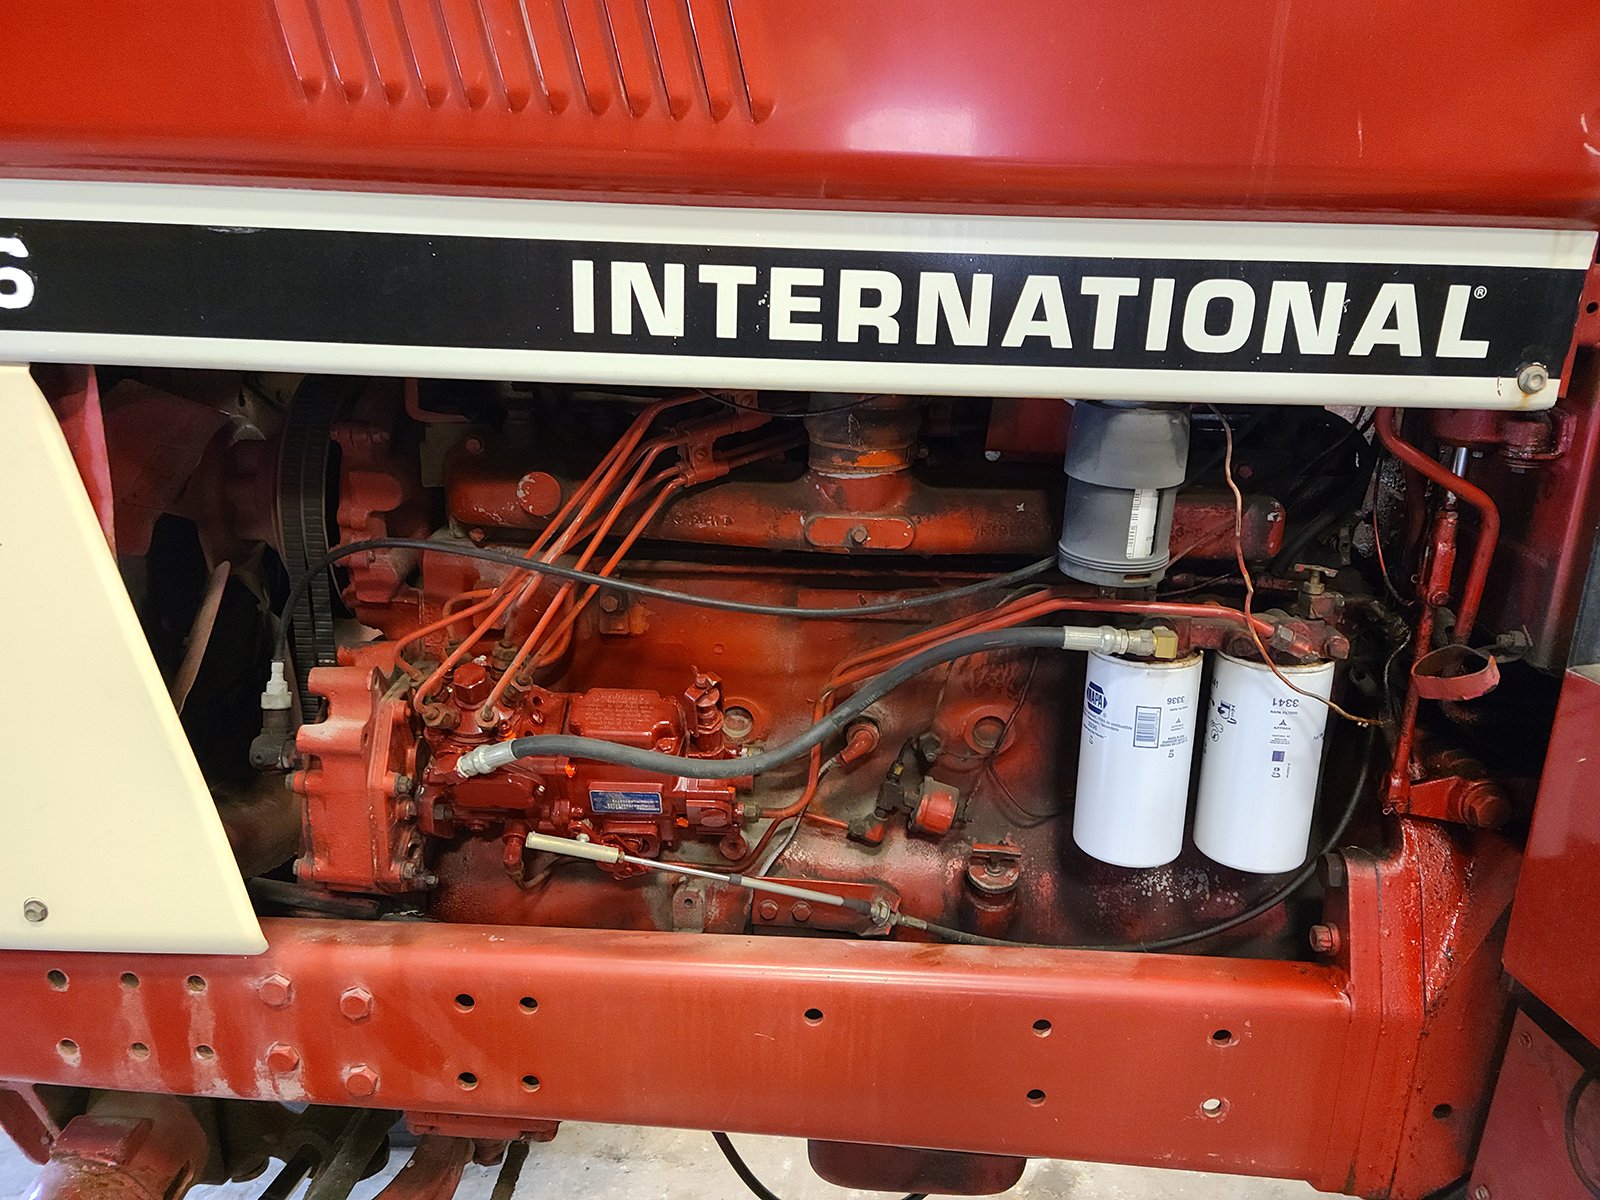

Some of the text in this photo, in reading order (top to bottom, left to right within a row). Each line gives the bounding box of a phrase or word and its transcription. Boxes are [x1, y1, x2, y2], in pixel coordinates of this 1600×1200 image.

[0, 237, 35, 309] 6
[1167, 695, 1185, 705] 3336
[1272, 697, 1299, 708] 3341
